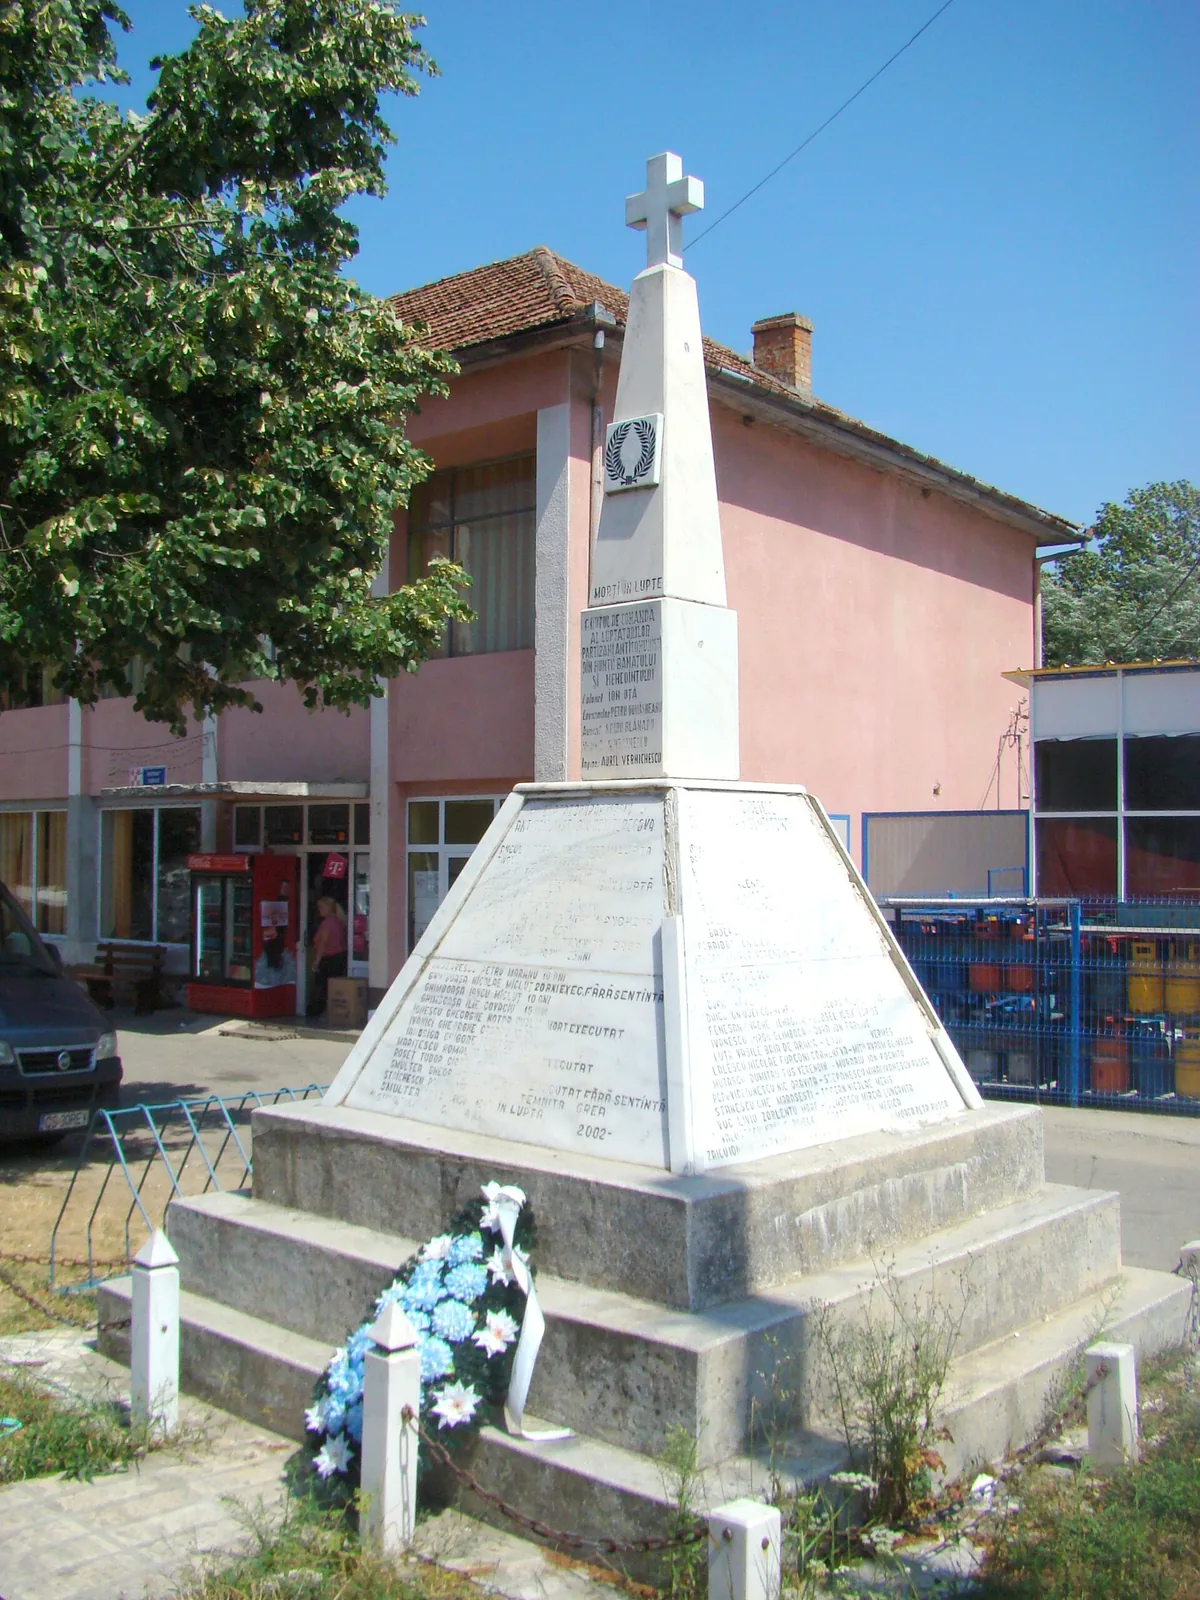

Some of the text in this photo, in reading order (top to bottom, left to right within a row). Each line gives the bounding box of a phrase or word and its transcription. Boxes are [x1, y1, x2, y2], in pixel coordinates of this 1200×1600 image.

[634, 577, 662, 592] LUPTE
[534, 982, 546, 992] 20
[446, 1008, 483, 1023] GHEORGHE
[569, 1022, 625, 1040] EXECUTAT
[380, 1081, 420, 1098] SMULTER
